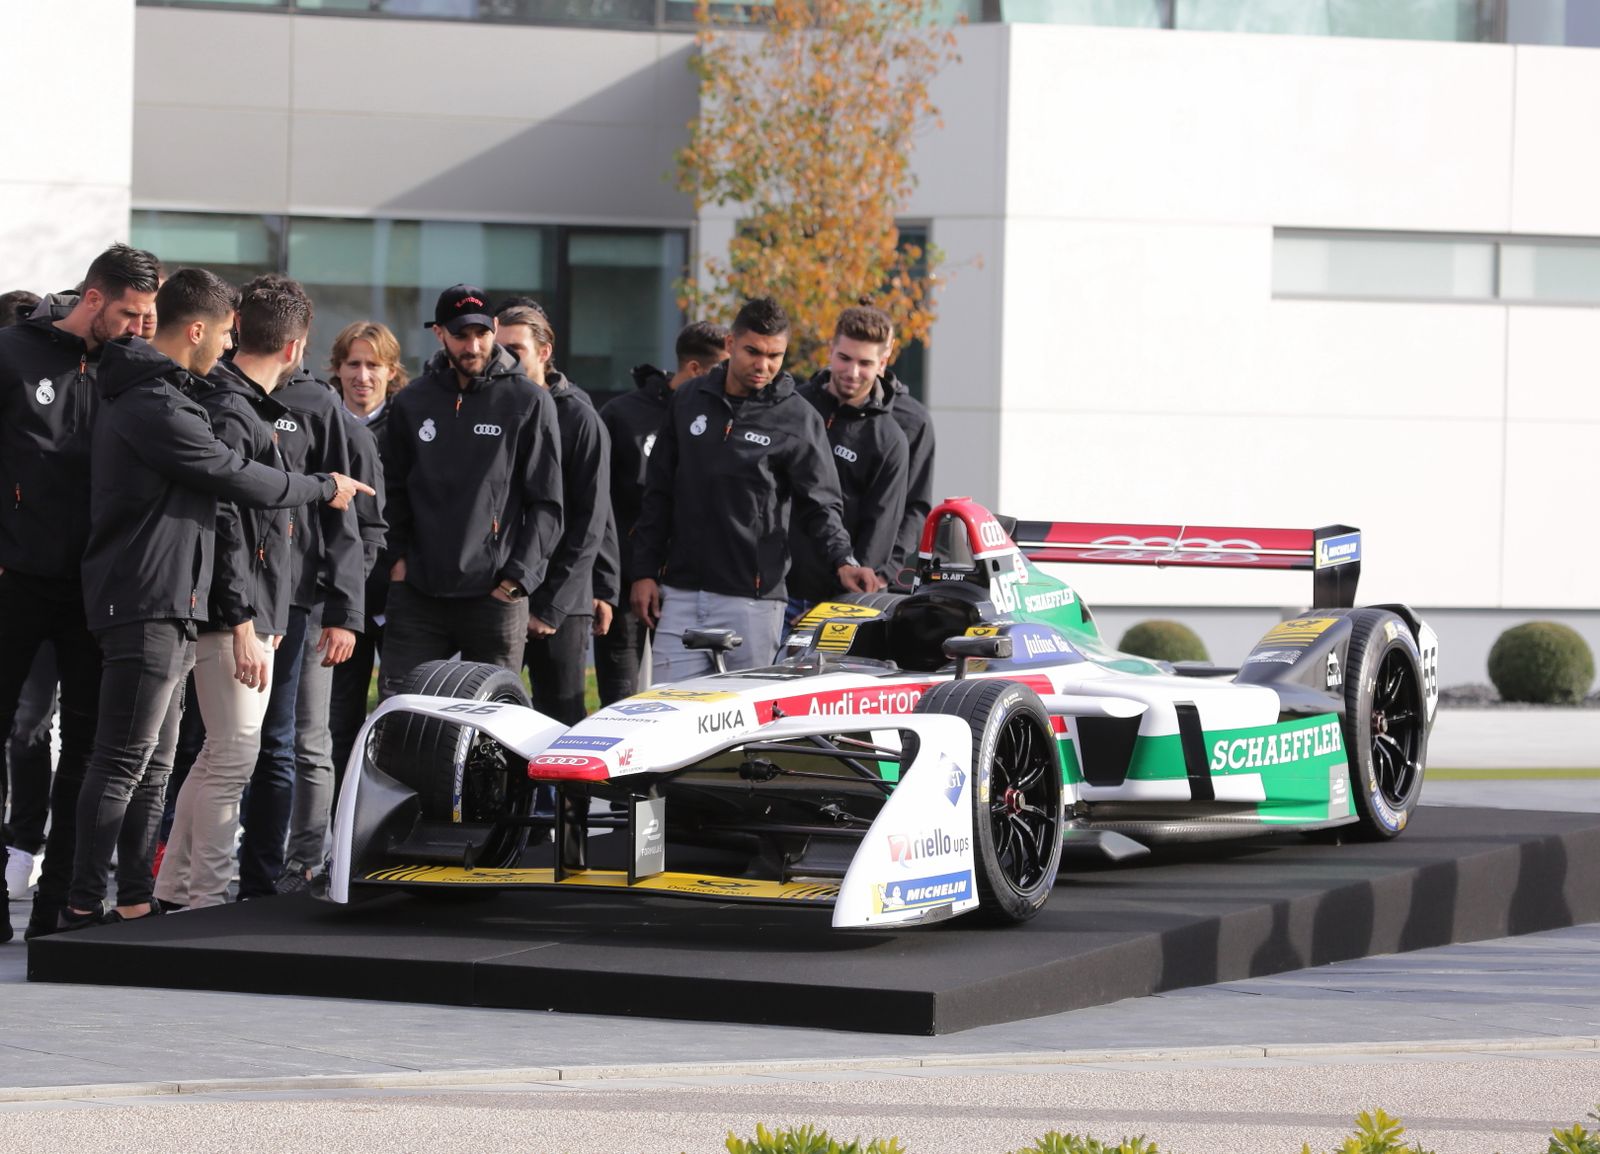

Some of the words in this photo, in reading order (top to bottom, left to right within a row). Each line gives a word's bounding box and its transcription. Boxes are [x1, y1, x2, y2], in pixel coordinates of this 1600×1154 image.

[950, 574, 965, 582] ABT
[990, 571, 1021, 615] ABT
[1023, 634, 1057, 659] Julius
[808, 692, 854, 715] Audi
[698, 710, 745, 735] KUKA
[1210, 720, 1342, 770] SCHAEFFLER
[913, 828, 951, 859] riello
[953, 836, 969, 856] ups
[906, 880, 967, 901] MICHELIN
